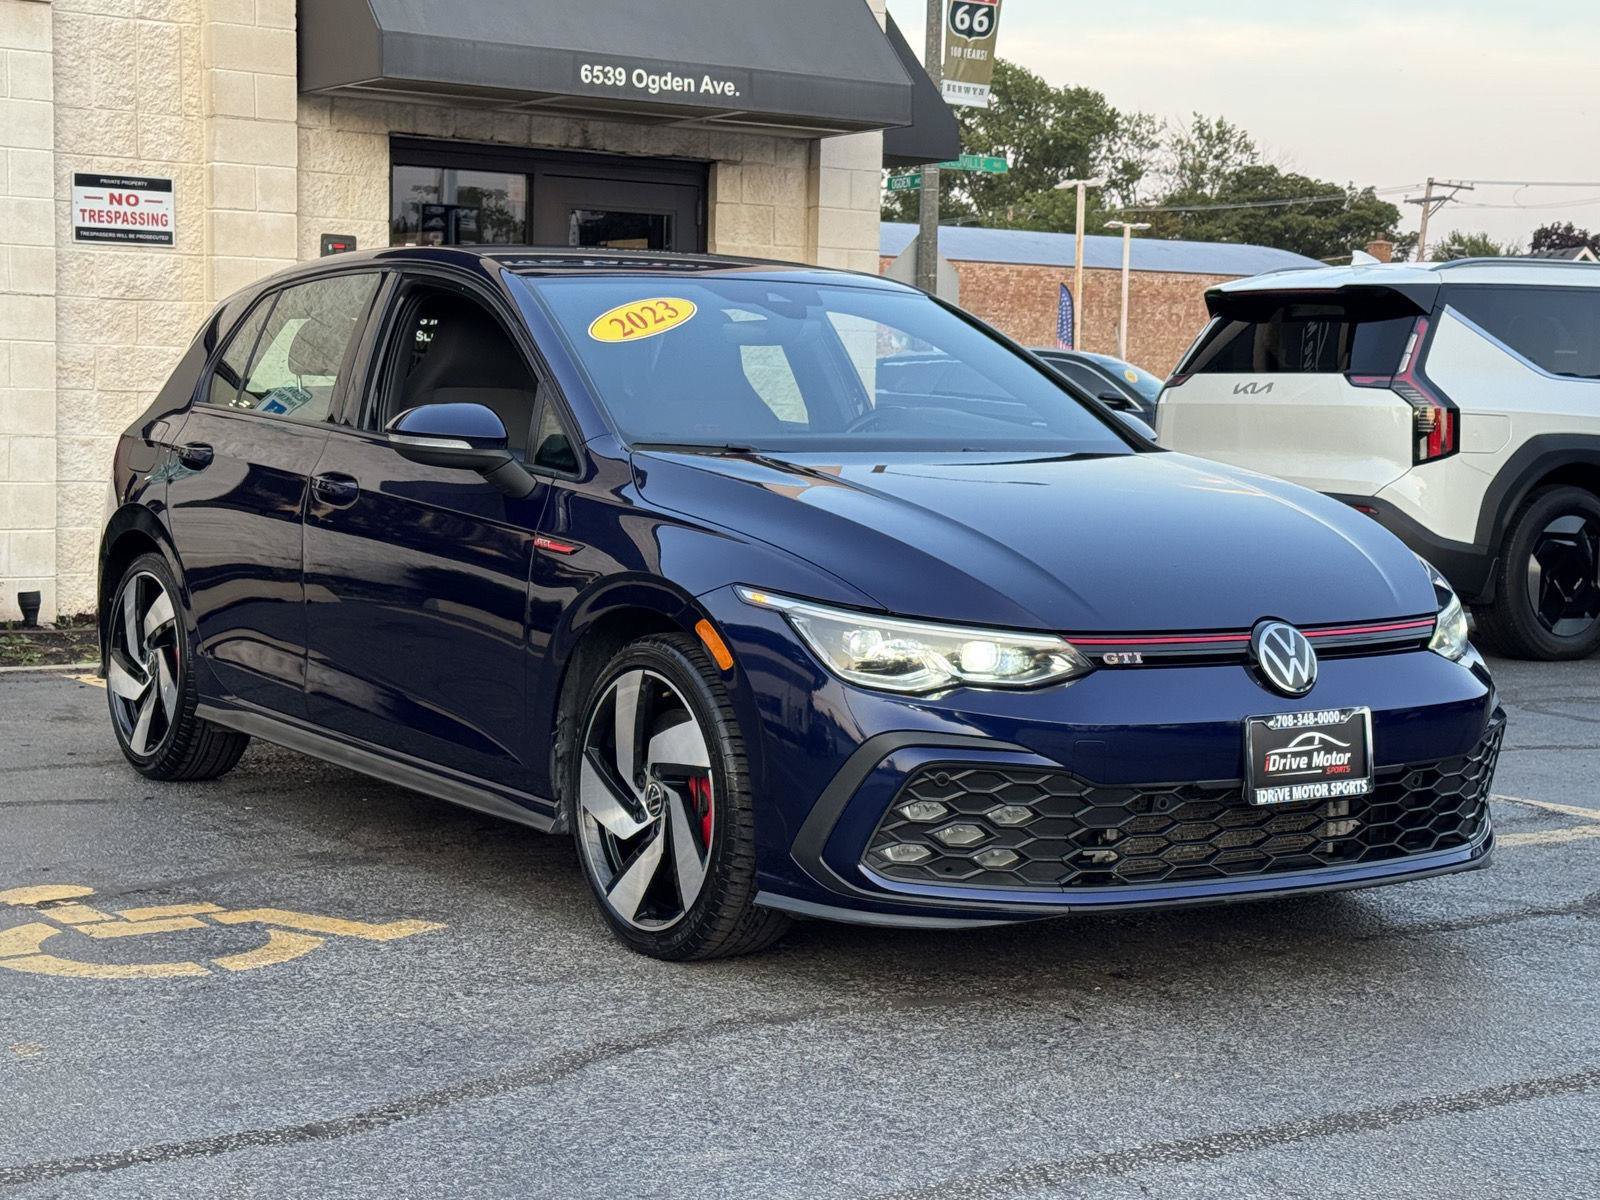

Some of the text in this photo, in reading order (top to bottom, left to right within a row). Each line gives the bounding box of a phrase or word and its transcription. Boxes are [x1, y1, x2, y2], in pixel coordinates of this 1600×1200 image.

[955, 4, 989, 32] 66
[580, 64, 740, 96] 6539 Ogden Ave.
[891, 178, 911, 189] OGDEN
[108, 192, 140, 207] NO
[79, 208, 169, 227] TRESPASSING
[80, 230, 116, 238] TRESPASSERS
[609, 301, 679, 338] 2023
[1102, 651, 1144, 665] GTI
[1276, 710, 1340, 728] 708-348-0000
[1264, 750, 1352, 773] iDrive Motor
[1326, 765, 1351, 775] SPORTS
[1292, 783, 1329, 799] MOTOR
[1330, 779, 1368, 796] SPORTS
